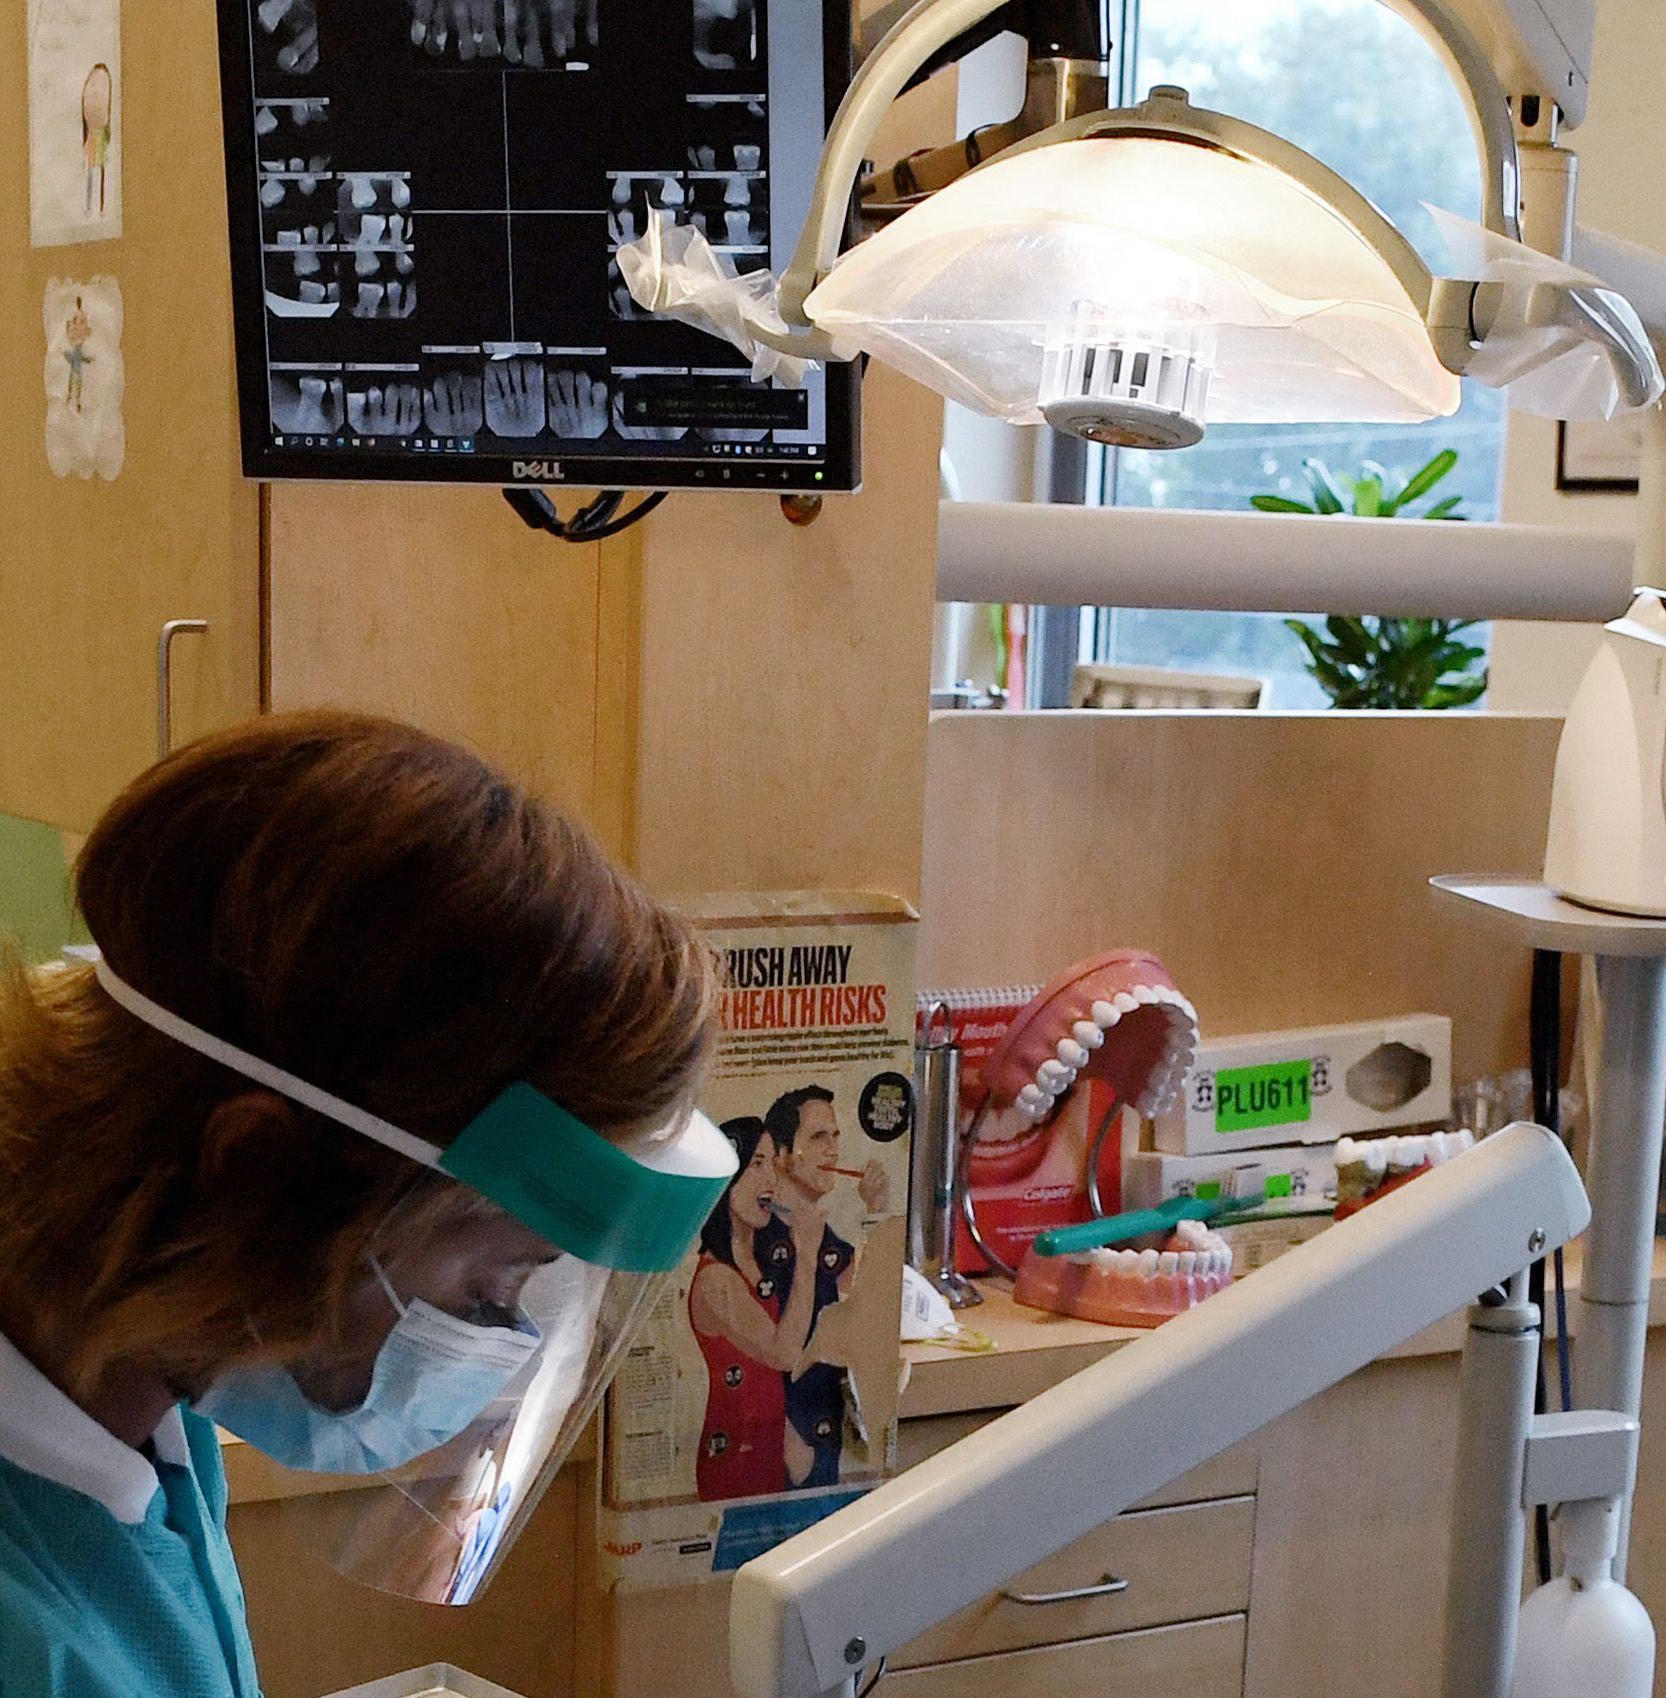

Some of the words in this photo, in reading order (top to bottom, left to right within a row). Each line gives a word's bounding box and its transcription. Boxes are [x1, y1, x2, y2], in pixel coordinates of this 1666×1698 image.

[512, 460, 565, 479] DELL
[719, 946, 785, 989] RUSH
[788, 944, 852, 987] AWAY
[732, 986, 817, 1030] HEALTH
[819, 984, 887, 1026] RISKS
[1218, 1075, 1308, 1116] PLU611
